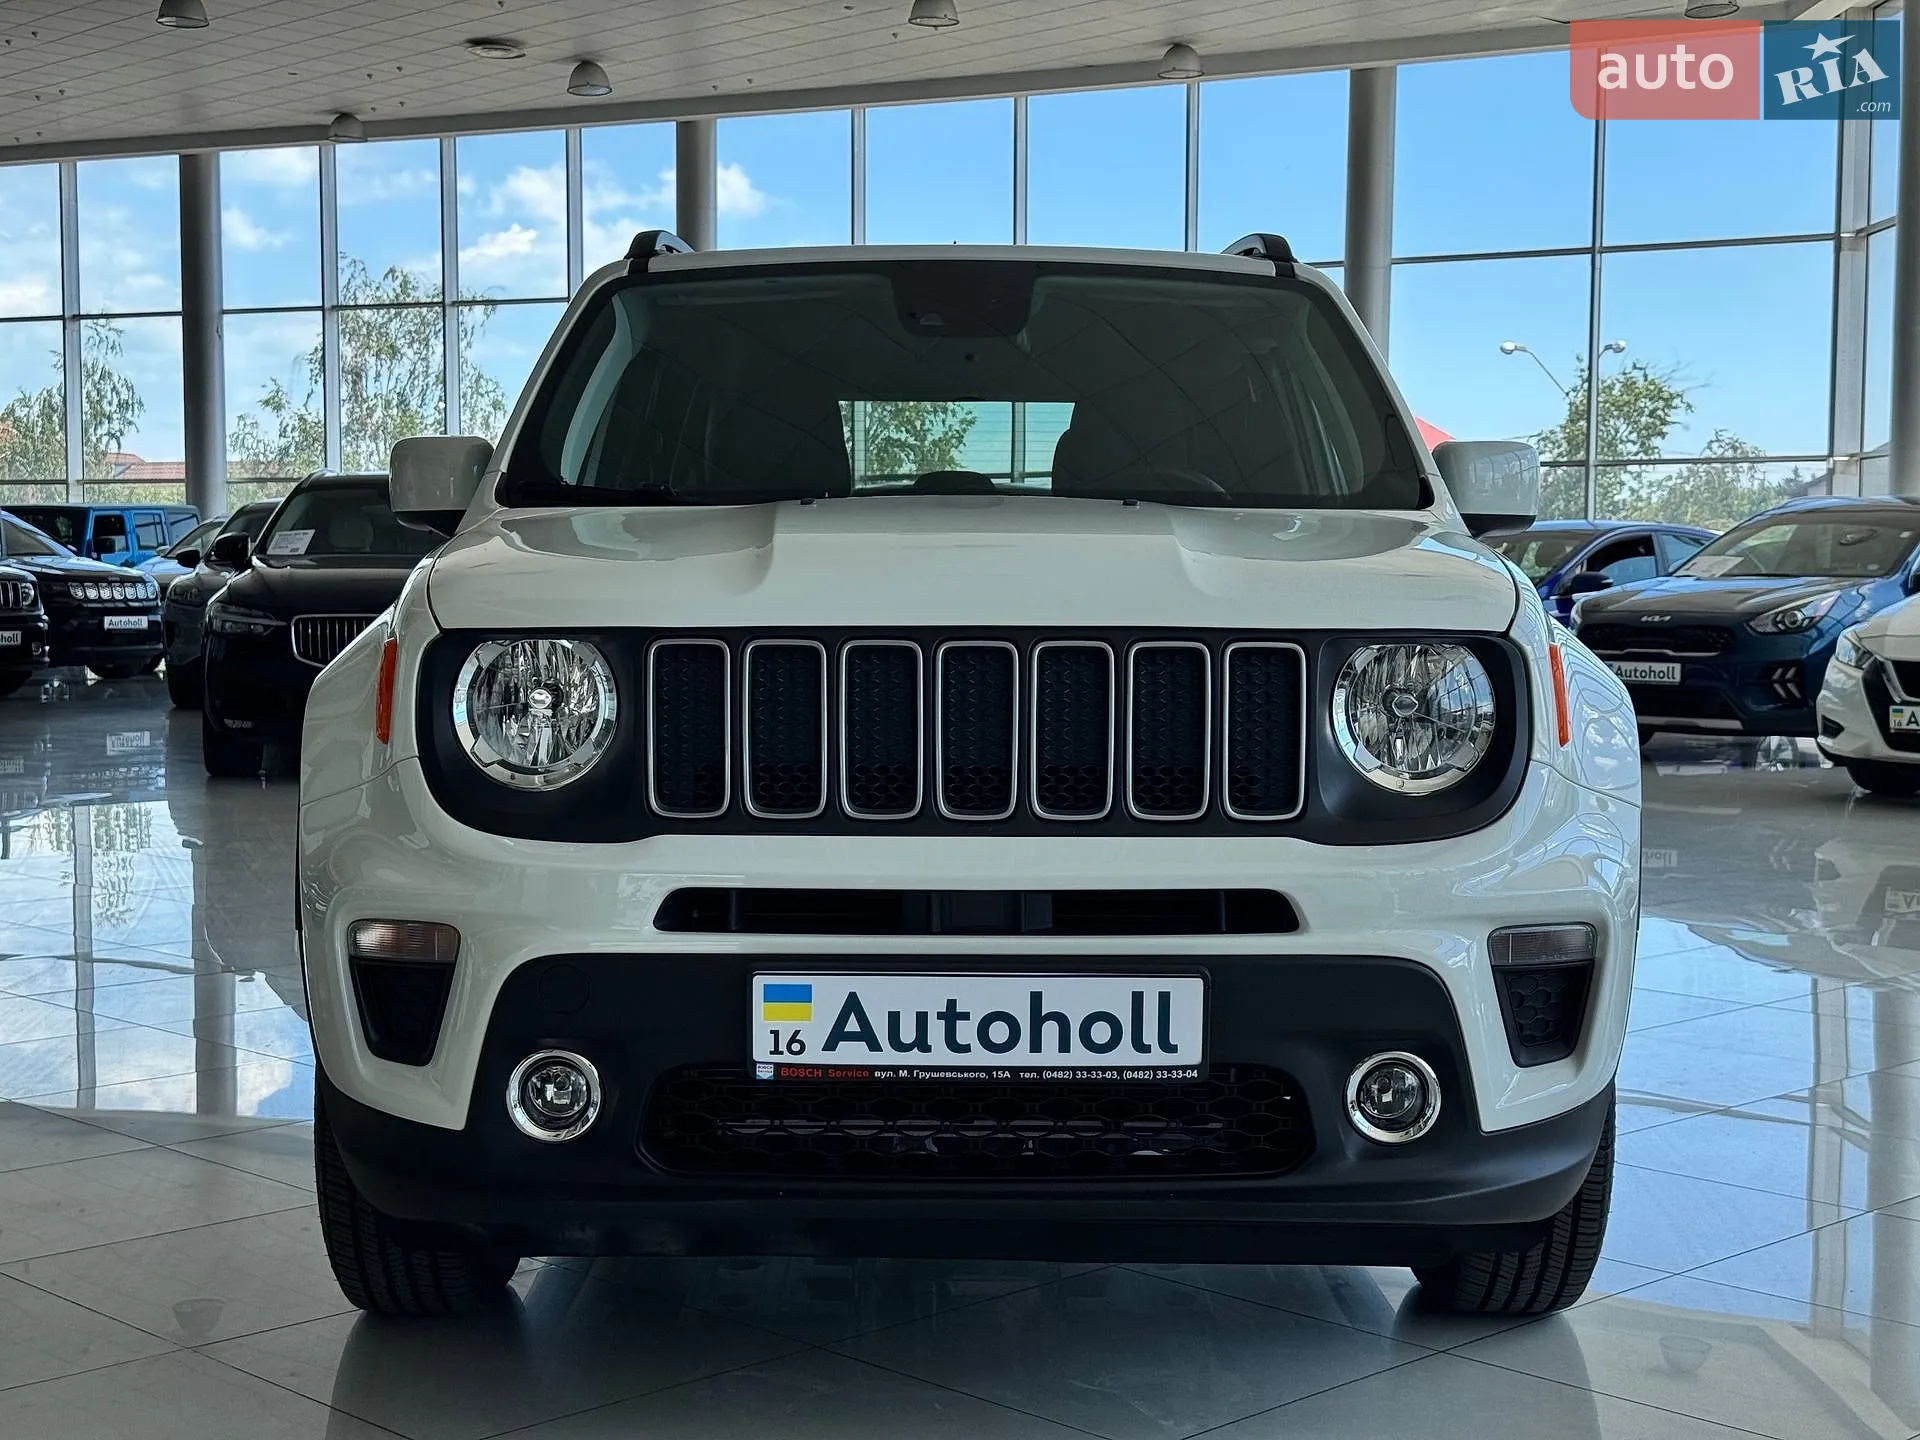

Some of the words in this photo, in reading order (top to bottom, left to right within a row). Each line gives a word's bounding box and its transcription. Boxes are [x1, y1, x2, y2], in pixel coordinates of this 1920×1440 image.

[1615, 664, 1676, 680] Autoholl
[821, 990, 1179, 1055] Autoholl
[769, 1029, 807, 1056] 16
[780, 1067, 822, 1077] BOSCH
[828, 1068, 870, 1078] Service
[874, 1070, 896, 1079] вул.
[899, 1070, 911, 1078] М.
[913, 1070, 989, 1080] Грушевського,
[1042, 1070, 1073, 1080] (0482)
[1075, 1070, 1120, 1080] 33-33-03,
[1123, 1070, 1154, 1080] (0482)
[1156, 1069, 1198, 1079] 33-33-04
